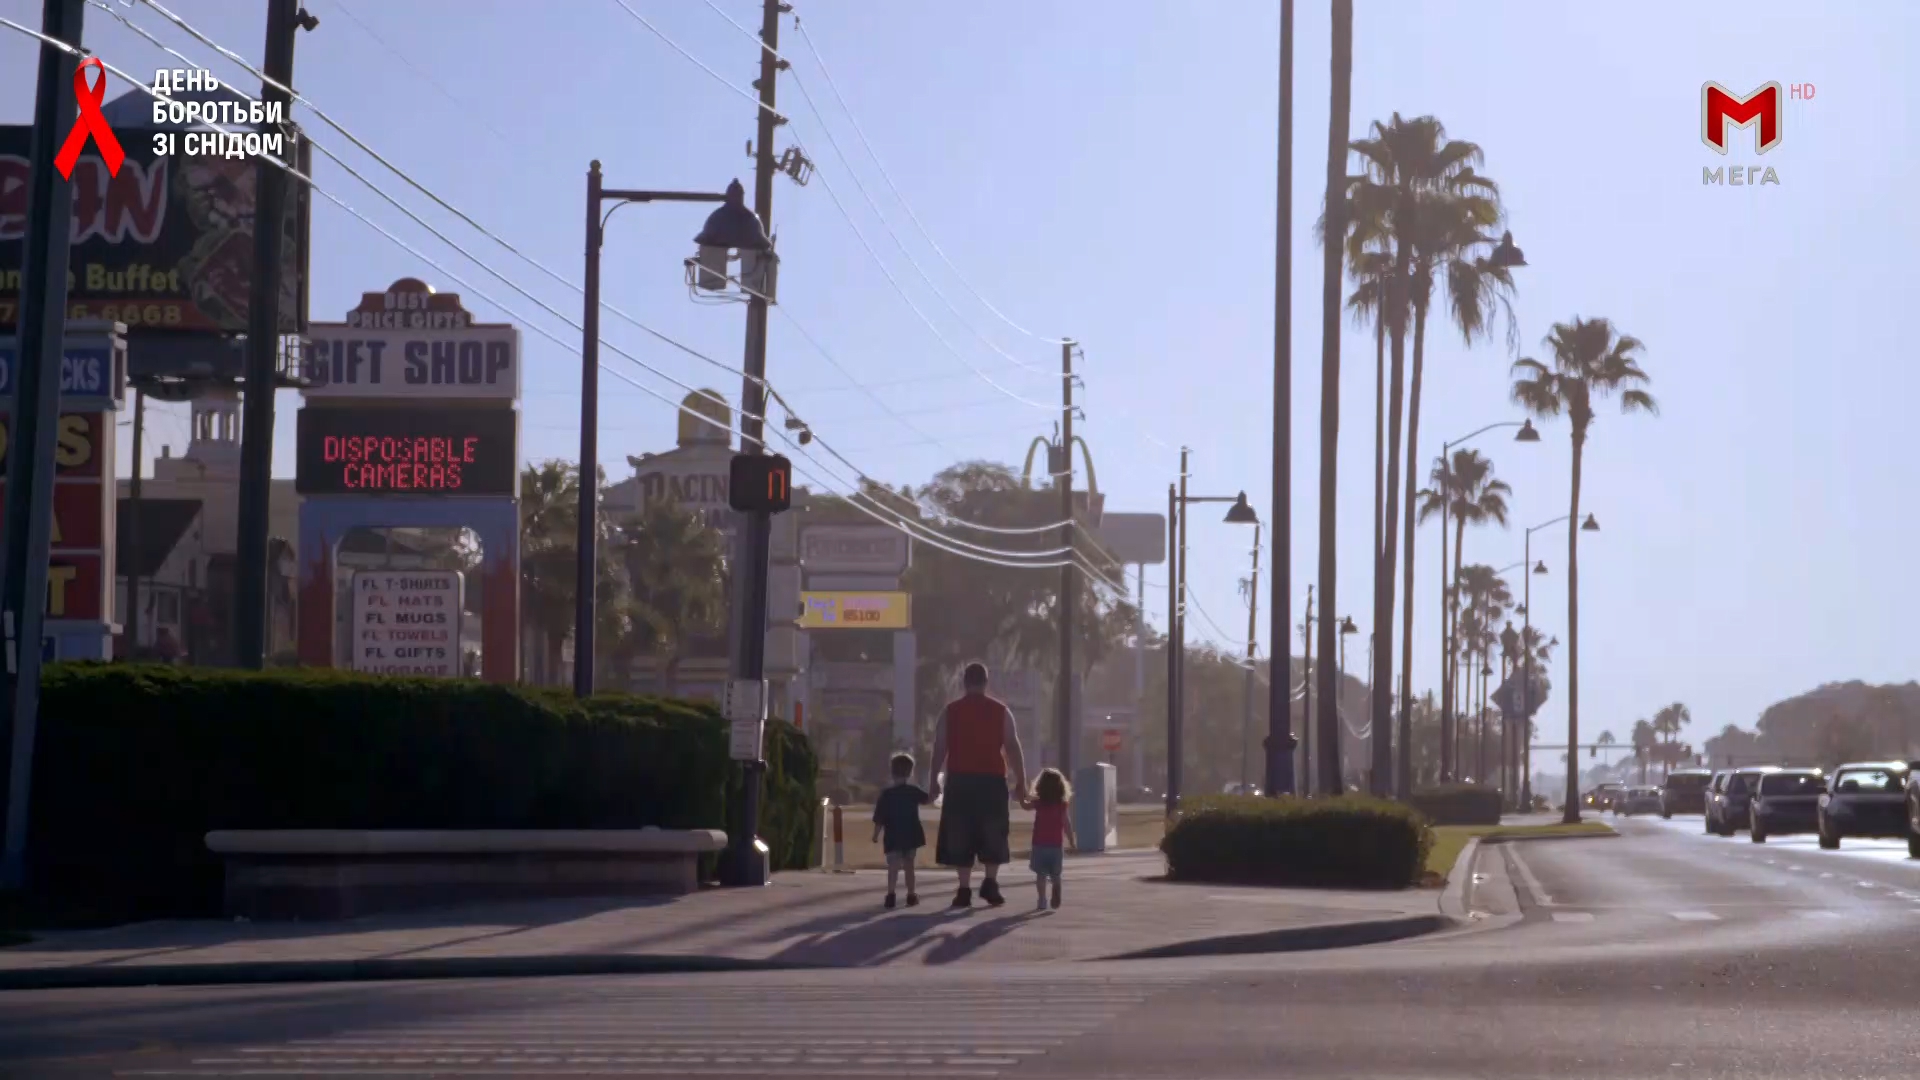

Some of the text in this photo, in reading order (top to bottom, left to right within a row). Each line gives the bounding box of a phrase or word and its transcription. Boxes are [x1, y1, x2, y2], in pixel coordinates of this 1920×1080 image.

[86, 263, 179, 291] Buffet
[384, 291, 428, 309] BEST
[348, 311, 465, 329] PRICE GIFTS
[304, 340, 510, 386] GIFT SHOP
[323, 435, 479, 463] DISPOSABLE
[343, 463, 463, 488] CAMERAS
[362, 578, 450, 590] FL T-SHIRTS
[367, 595, 444, 607] FL HATS
[365, 613, 446, 624] FL MUGS
[362, 630, 448, 642] FL TOWELS
[365, 647, 446, 659] FL GIFTS
